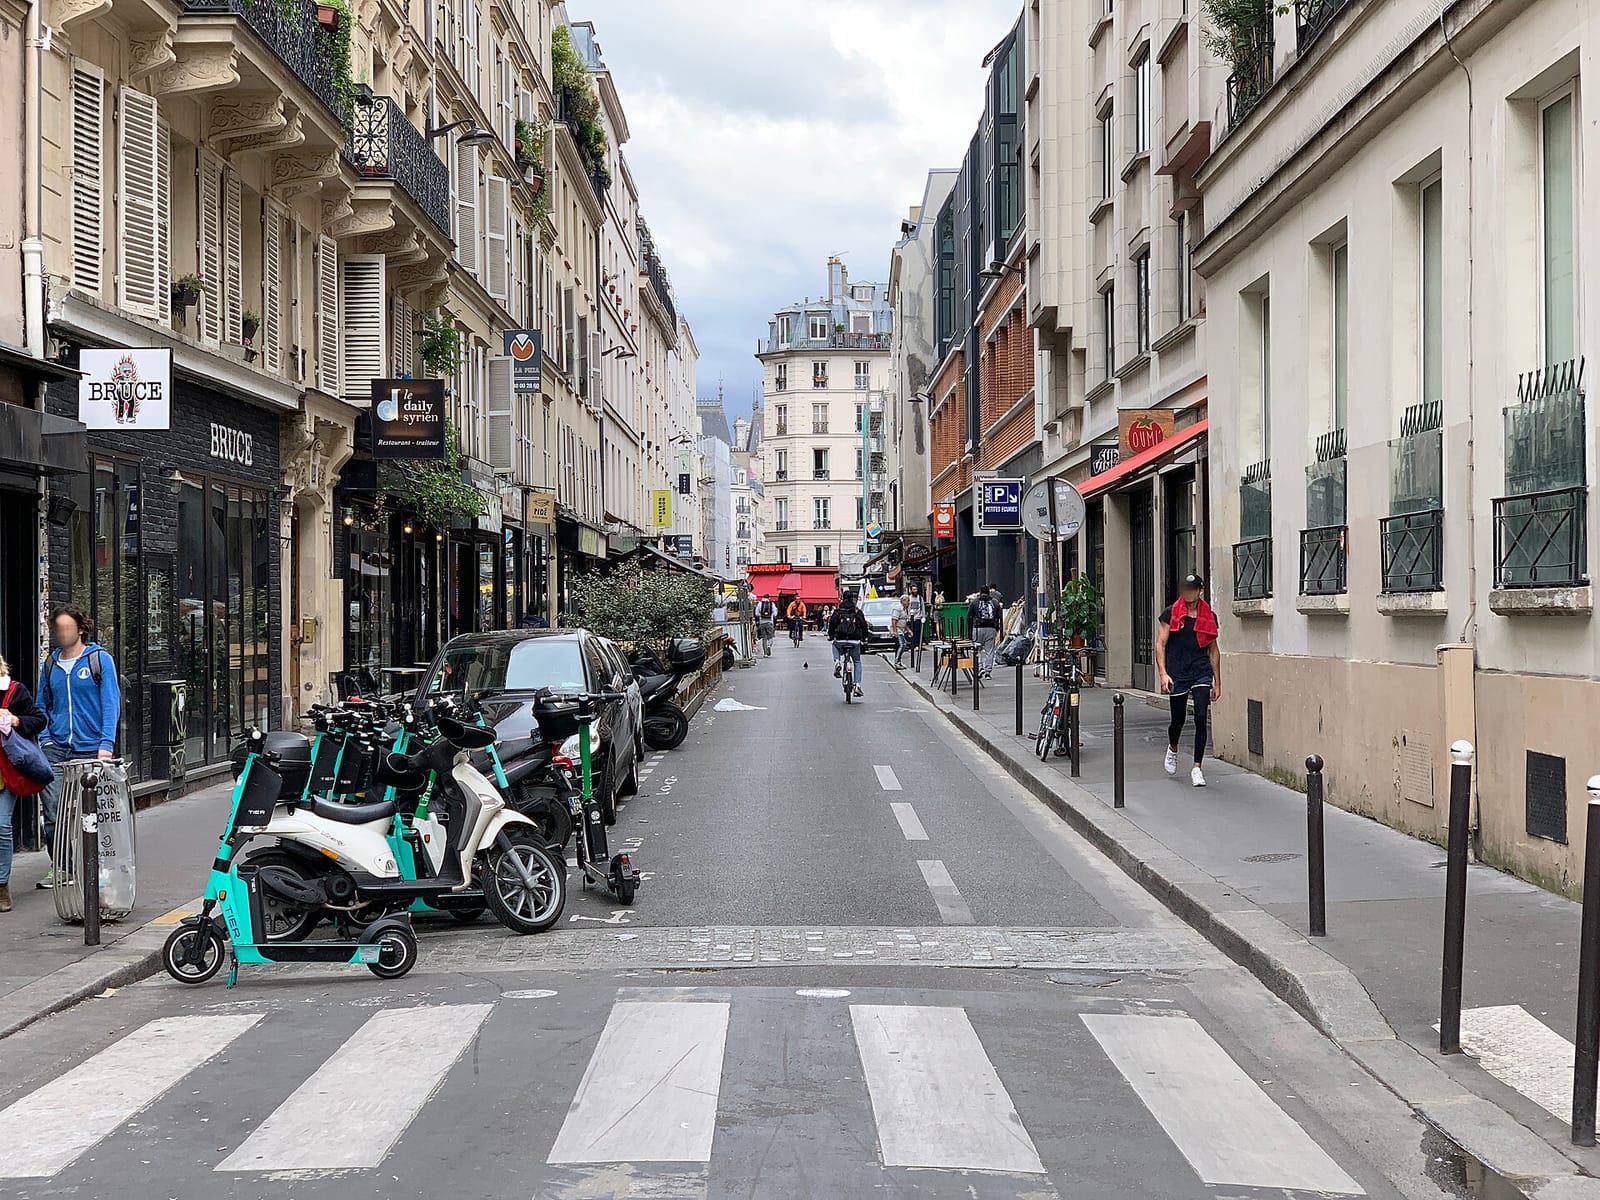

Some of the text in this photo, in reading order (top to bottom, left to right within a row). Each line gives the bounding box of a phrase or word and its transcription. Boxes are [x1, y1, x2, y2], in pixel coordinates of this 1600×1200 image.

[88, 382, 162, 401] BRUCE
[403, 389, 413, 400] le
[403, 400, 433, 414] daily
[402, 412, 439, 425] syrien
[210, 422, 253, 466] BRUCE
[995, 487, 1005, 502] P
[418, 780, 434, 807] Lime
[97, 811, 122, 823] OPRE
[225, 904, 241, 938] TIER
